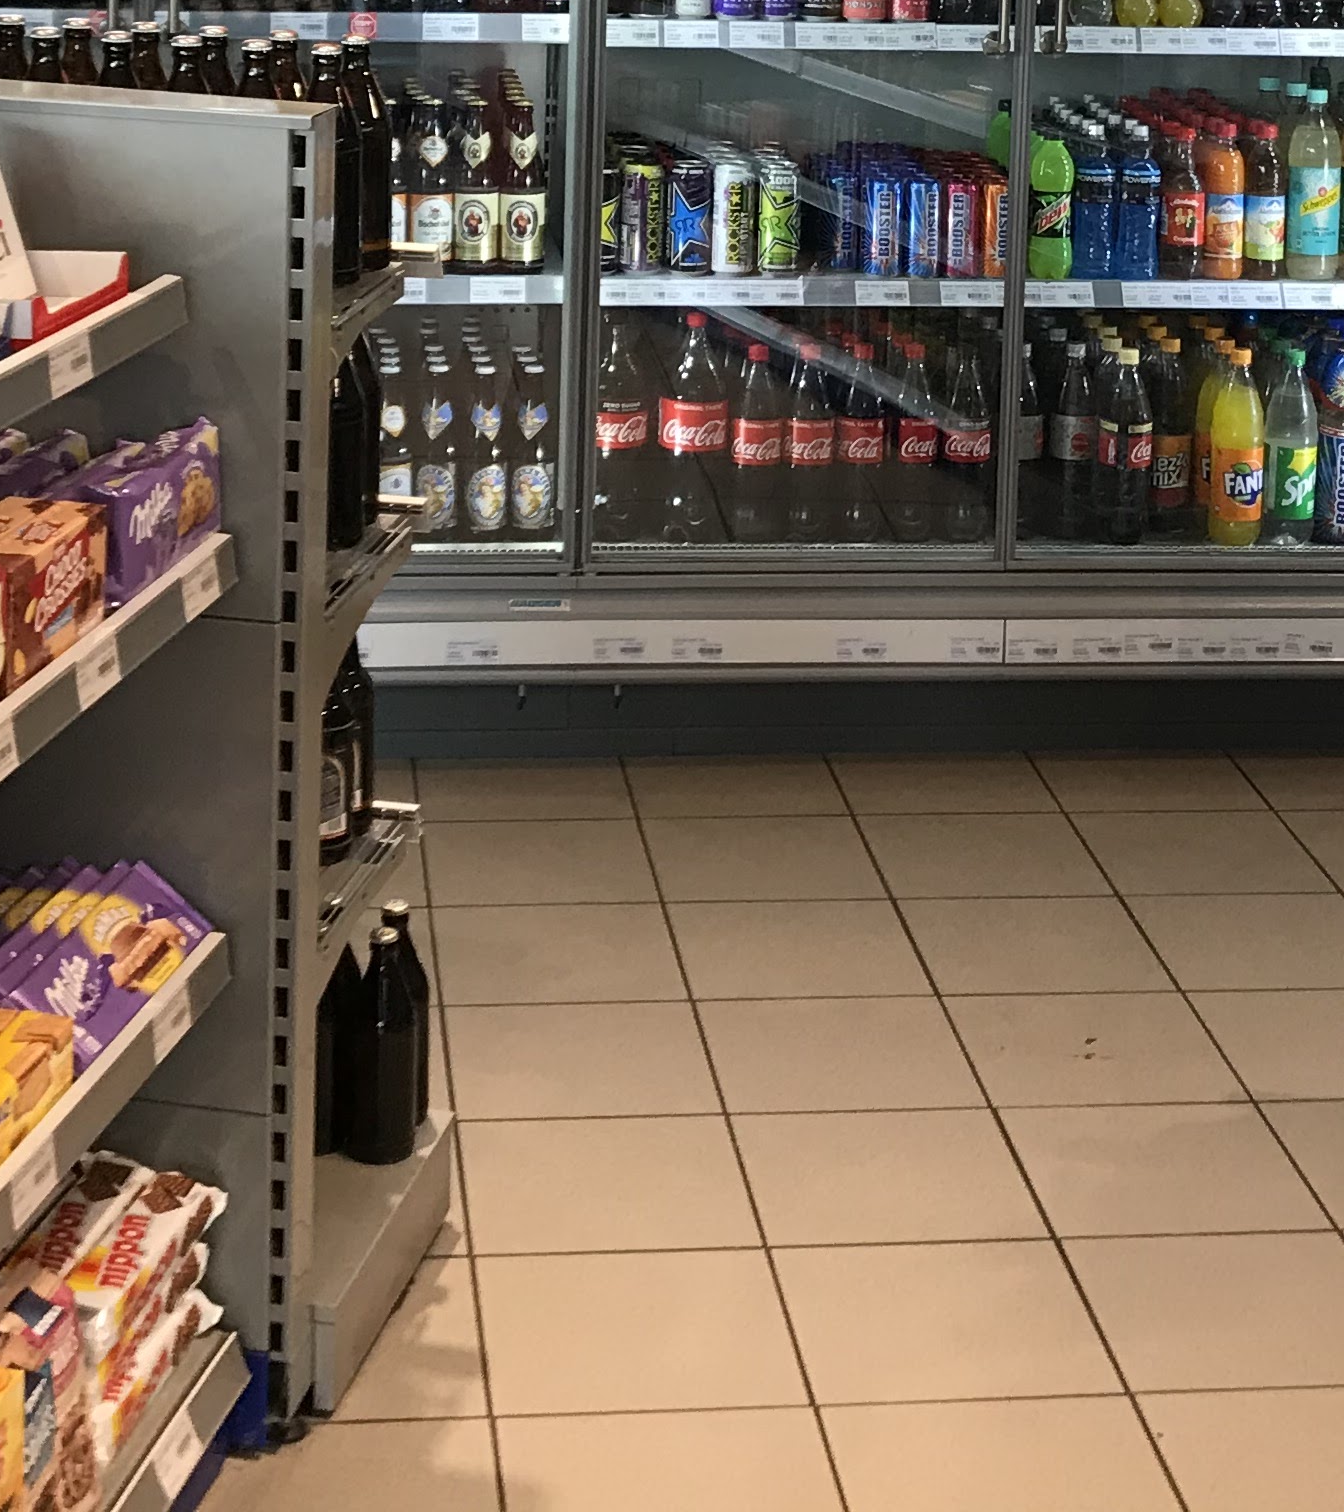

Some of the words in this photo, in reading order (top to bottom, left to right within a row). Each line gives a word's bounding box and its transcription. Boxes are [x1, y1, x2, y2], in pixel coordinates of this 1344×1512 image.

[877, 191, 892, 258] BOOSTER
[951, 192, 965, 259] BOOSTER
[662, 420, 727, 448] Coca-Cola
[129, 482, 174, 547] Milka
[1224, 472, 1263, 497] FANT
[98, 1212, 148, 1288] nippon
